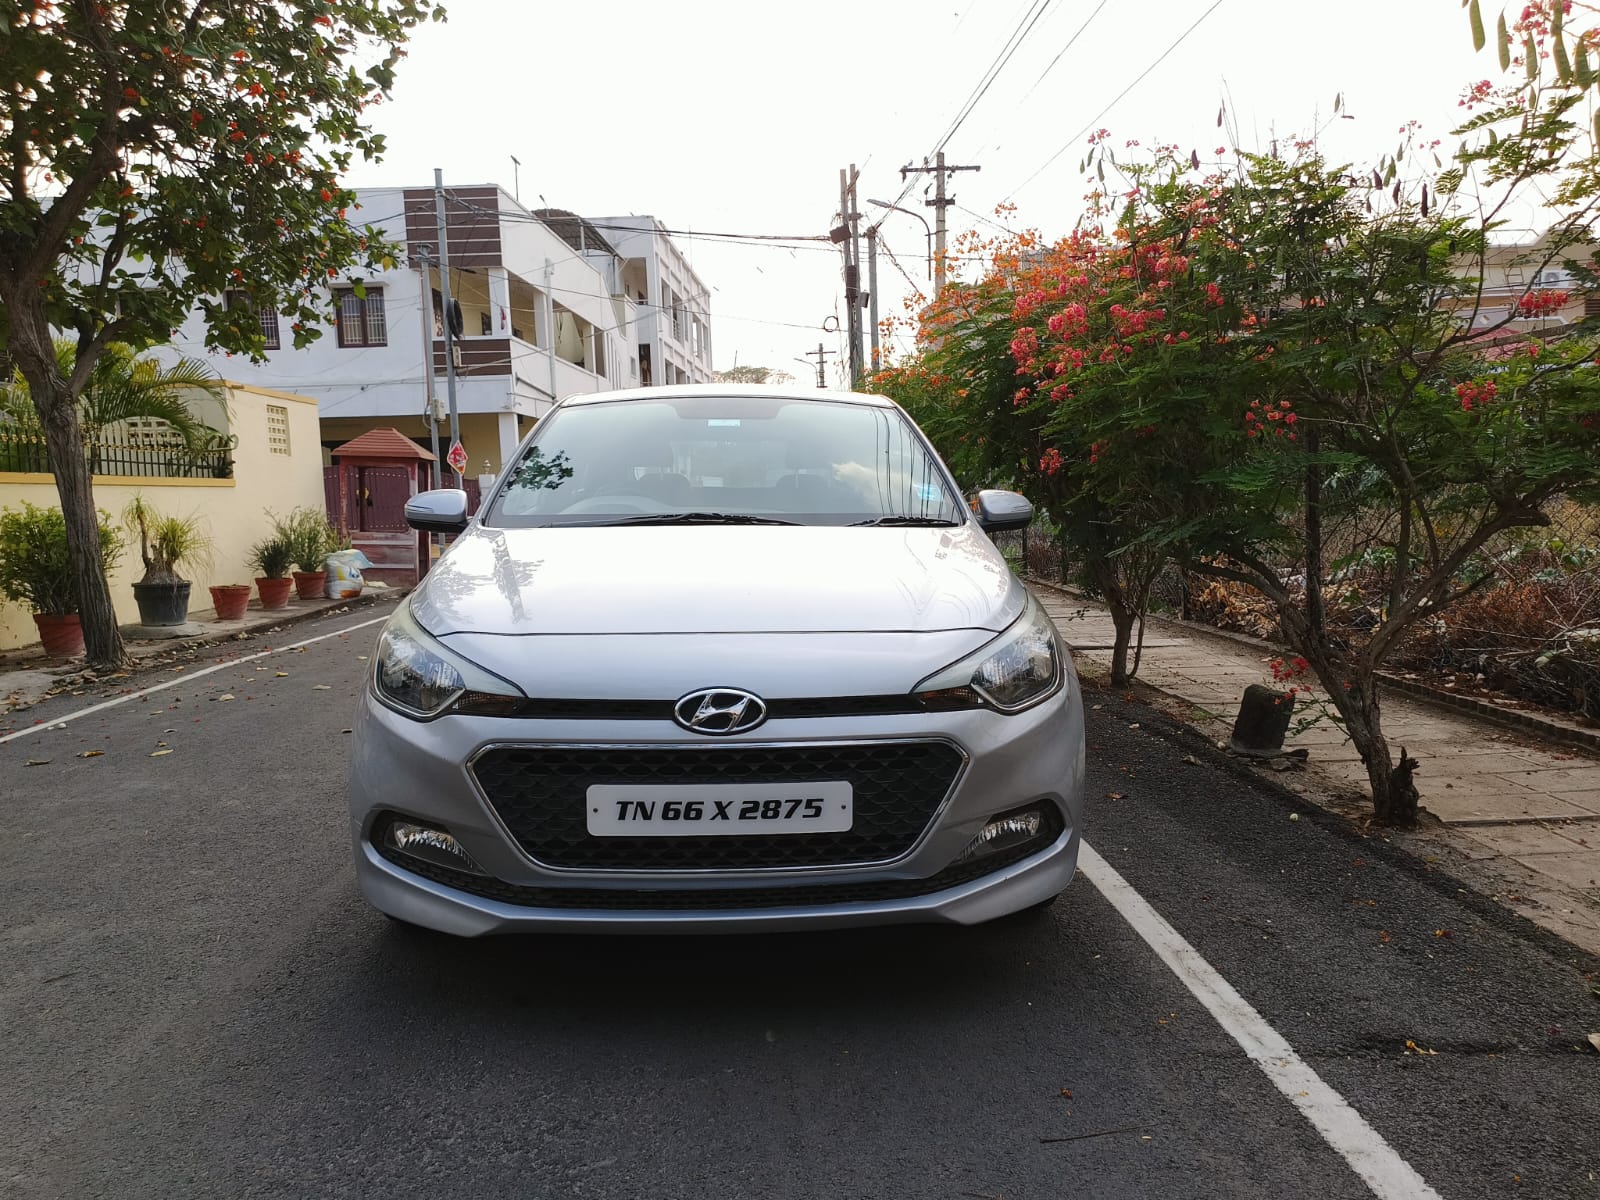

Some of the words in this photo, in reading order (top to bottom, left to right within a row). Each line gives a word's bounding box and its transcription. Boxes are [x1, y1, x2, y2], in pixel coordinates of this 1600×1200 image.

[616, 800, 657, 821] TN
[661, 800, 705, 821] 66
[709, 800, 735, 821] X
[738, 798, 825, 821] 2875
